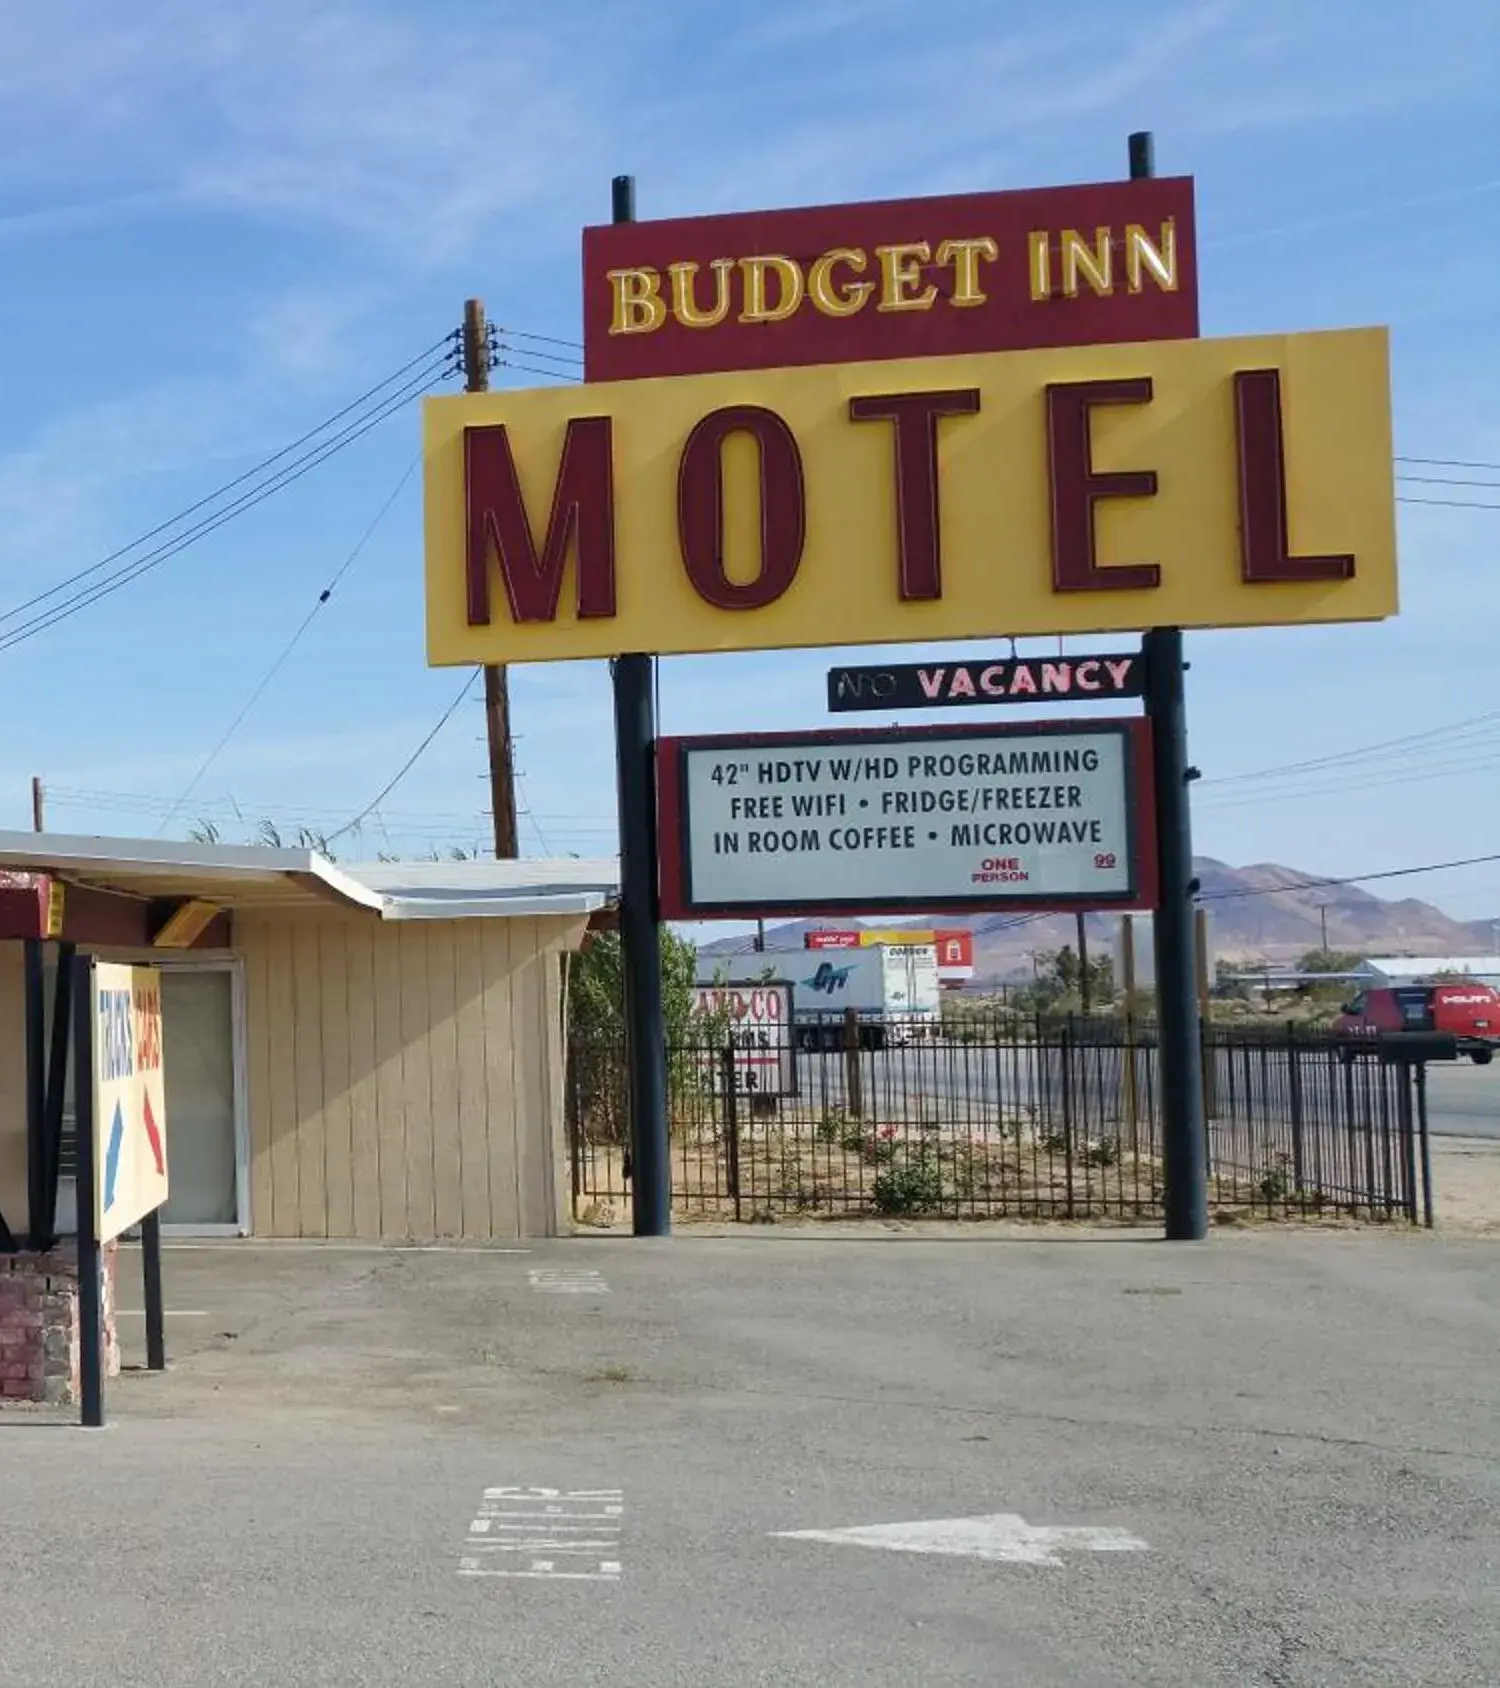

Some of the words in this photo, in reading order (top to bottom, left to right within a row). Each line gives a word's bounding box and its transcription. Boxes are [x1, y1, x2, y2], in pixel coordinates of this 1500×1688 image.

[607, 237, 999, 337] BUDGET
[1028, 216, 1180, 302] INN
[463, 366, 1356, 627] MOTEL
[836, 670, 898, 698] NO
[916, 659, 1133, 698] VACANCY
[711, 763, 749, 786] 42"
[757, 760, 822, 784] HDTV
[829, 757, 899, 783] W/HD
[907, 749, 1100, 779] PROGRAMMING
[730, 795, 784, 820] FREE
[791, 793, 846, 817] WIFI
[881, 785, 1082, 815] FRIDGE/FREEZER
[713, 831, 739, 854] IN
[747, 829, 821, 853] ROOM
[828, 826, 916, 851] COFFEE
[951, 819, 1103, 847] MICROWAVE
[971, 871, 1030, 884] PERSON
[980, 857, 1021, 872] ONE
[1094, 853, 1117, 869] 99
